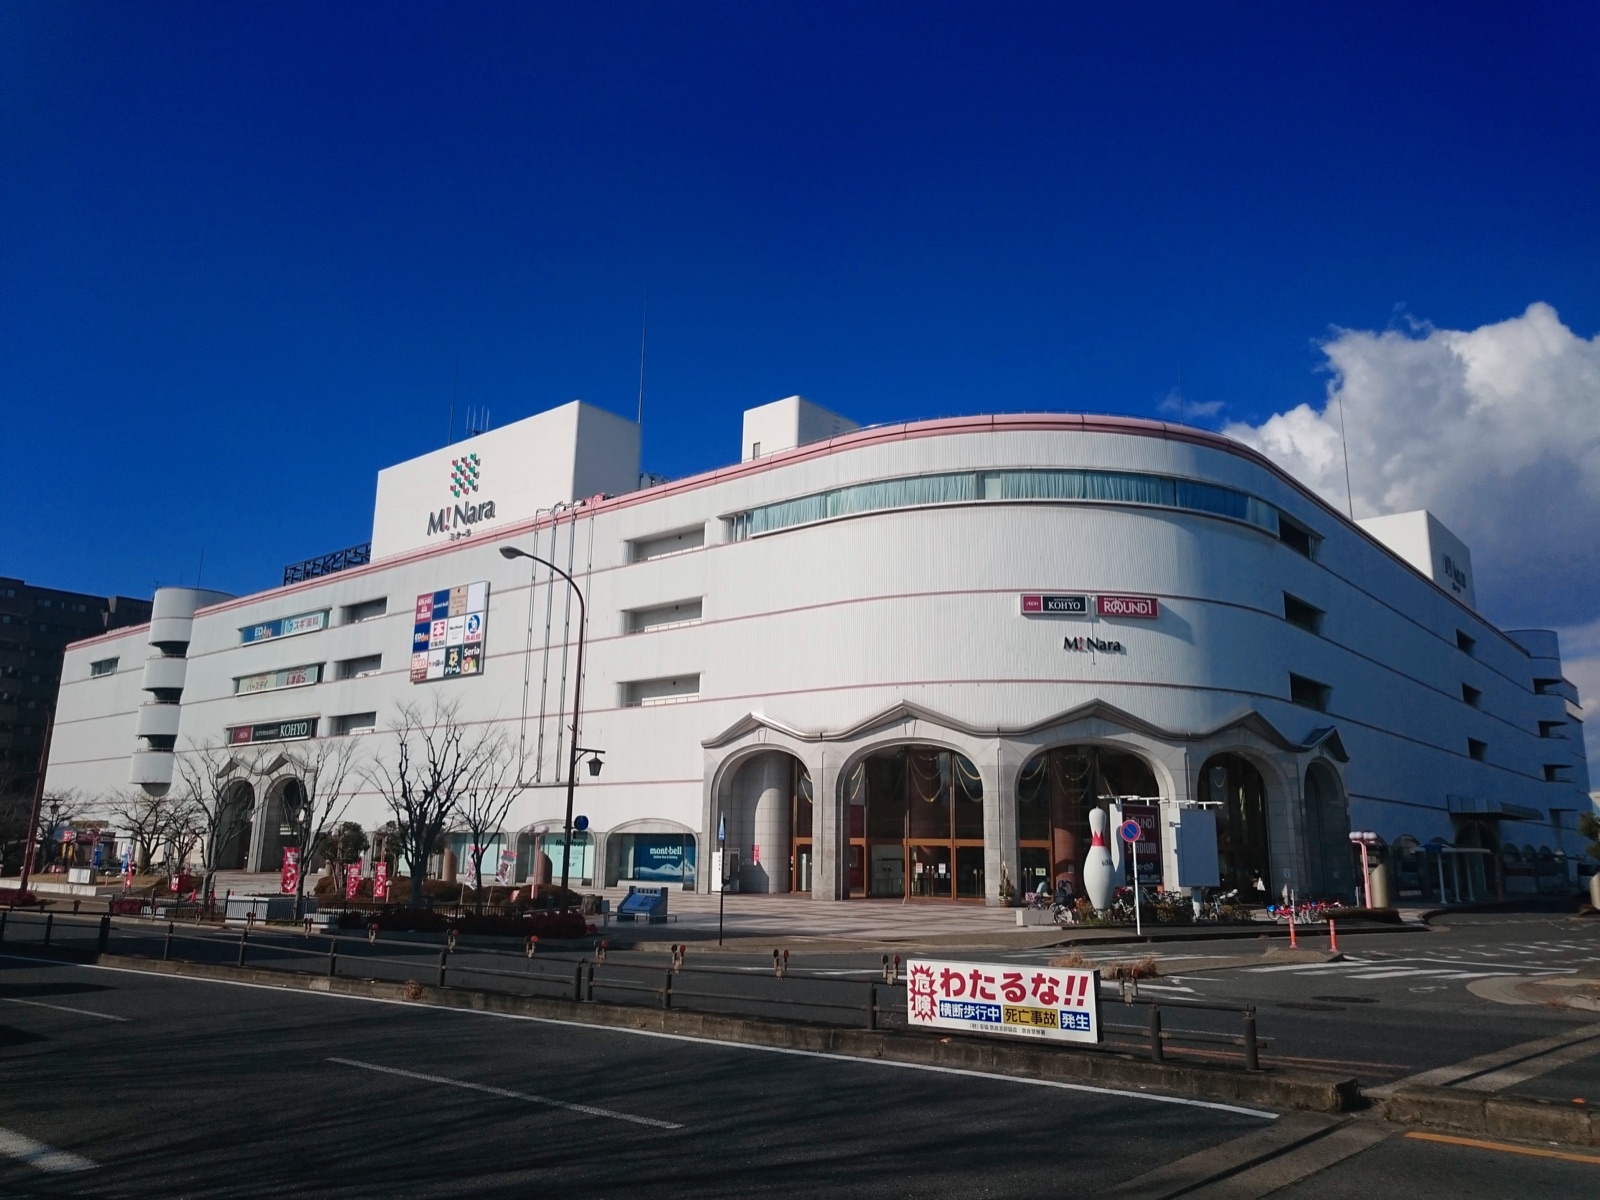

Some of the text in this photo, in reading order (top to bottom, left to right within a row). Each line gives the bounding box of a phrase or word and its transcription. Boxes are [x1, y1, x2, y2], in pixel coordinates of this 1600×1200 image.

[1048, 601, 1080, 610] KOHYO
[1103, 599, 1152, 614] ROUND1
[464, 646, 480, 657] Seria
[280, 722, 307, 737] KOHYO
[914, 972, 932, 1015] 危険
[940, 968, 1088, 1006] わたるな!!
[941, 1002, 999, 1021] 横断歩行中
[1005, 1008, 1056, 1026] 死亡事故
[1062, 1013, 1089, 1030] 発生
